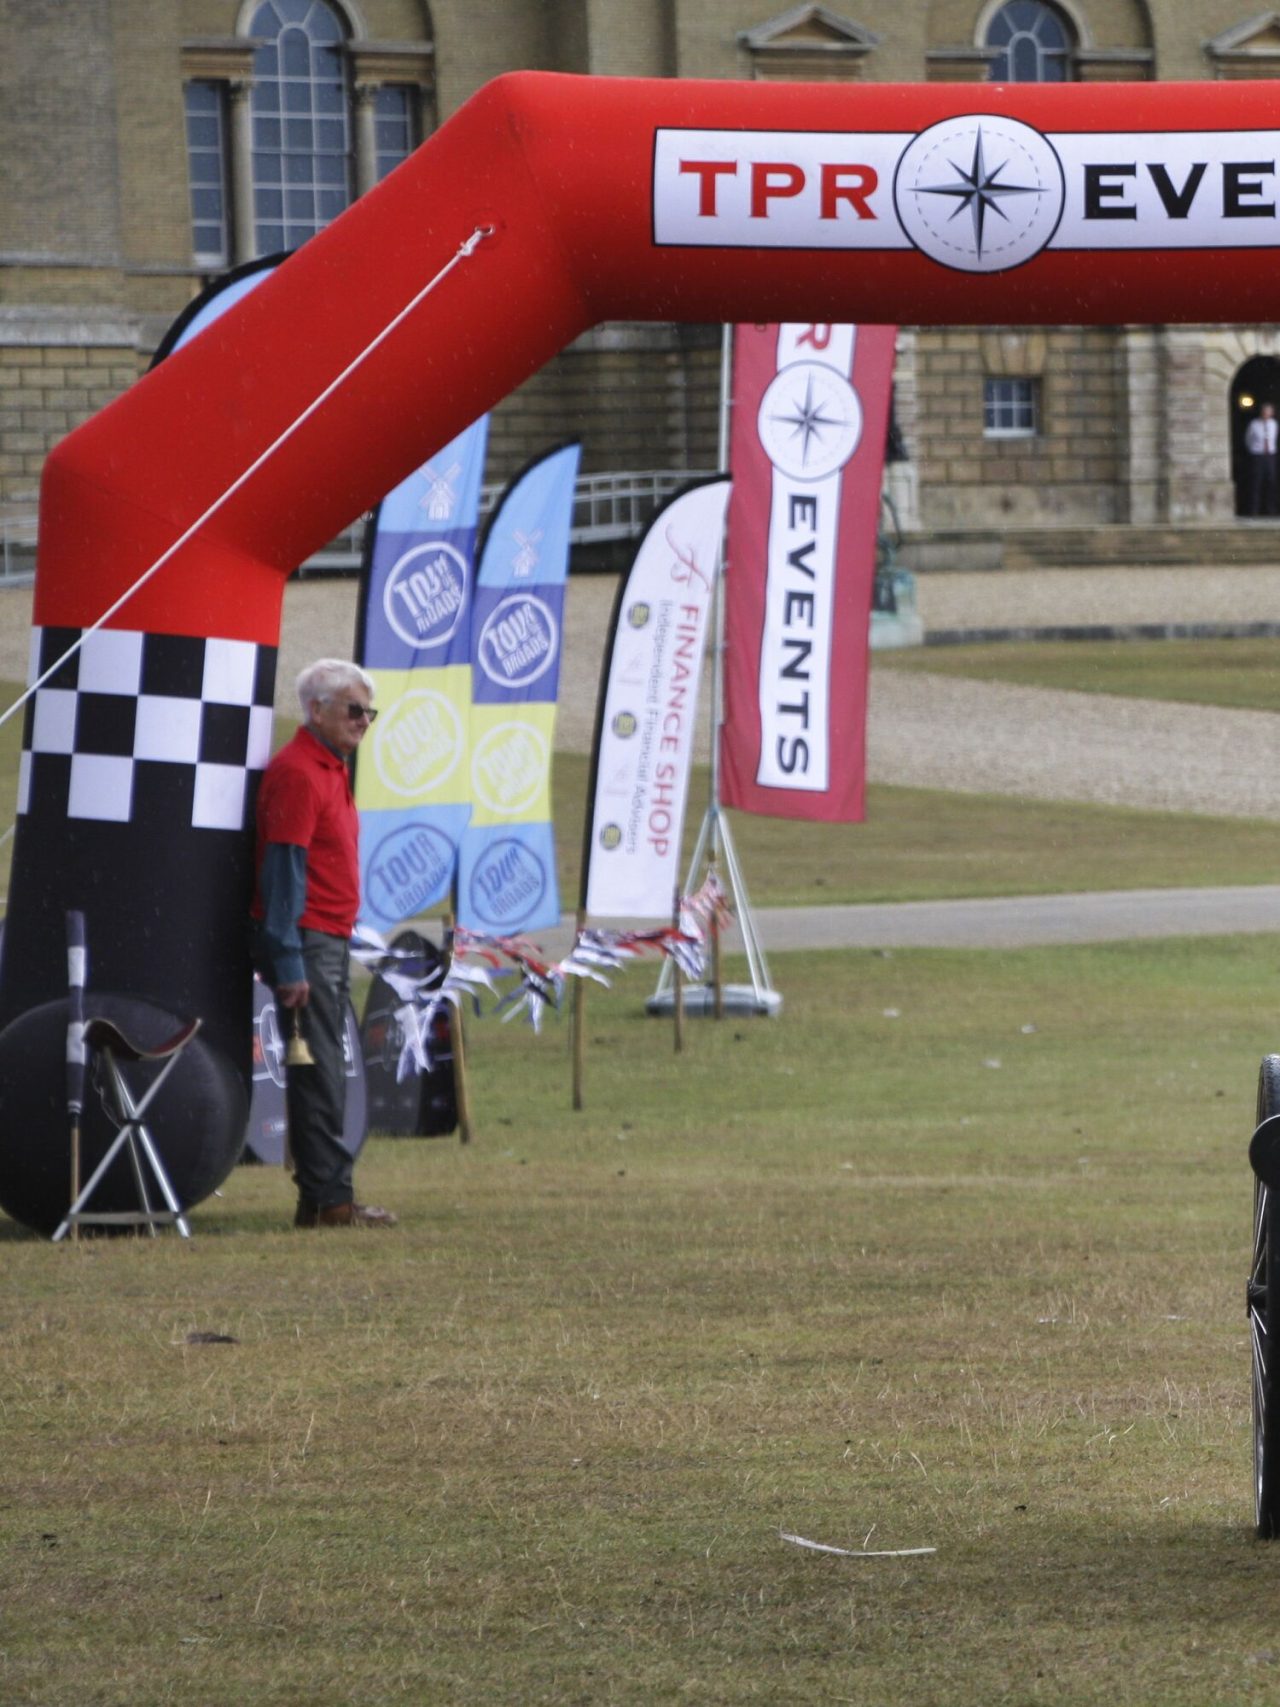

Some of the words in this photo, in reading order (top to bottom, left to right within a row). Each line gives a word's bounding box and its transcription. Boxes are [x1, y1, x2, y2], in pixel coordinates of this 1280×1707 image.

[679, 158, 880, 221] TPR
[659, 604, 699, 753] FINANCE
[777, 494, 818, 775] EVENTS
[647, 762, 676, 858] SHOP
[372, 832, 437, 897] TOUR
